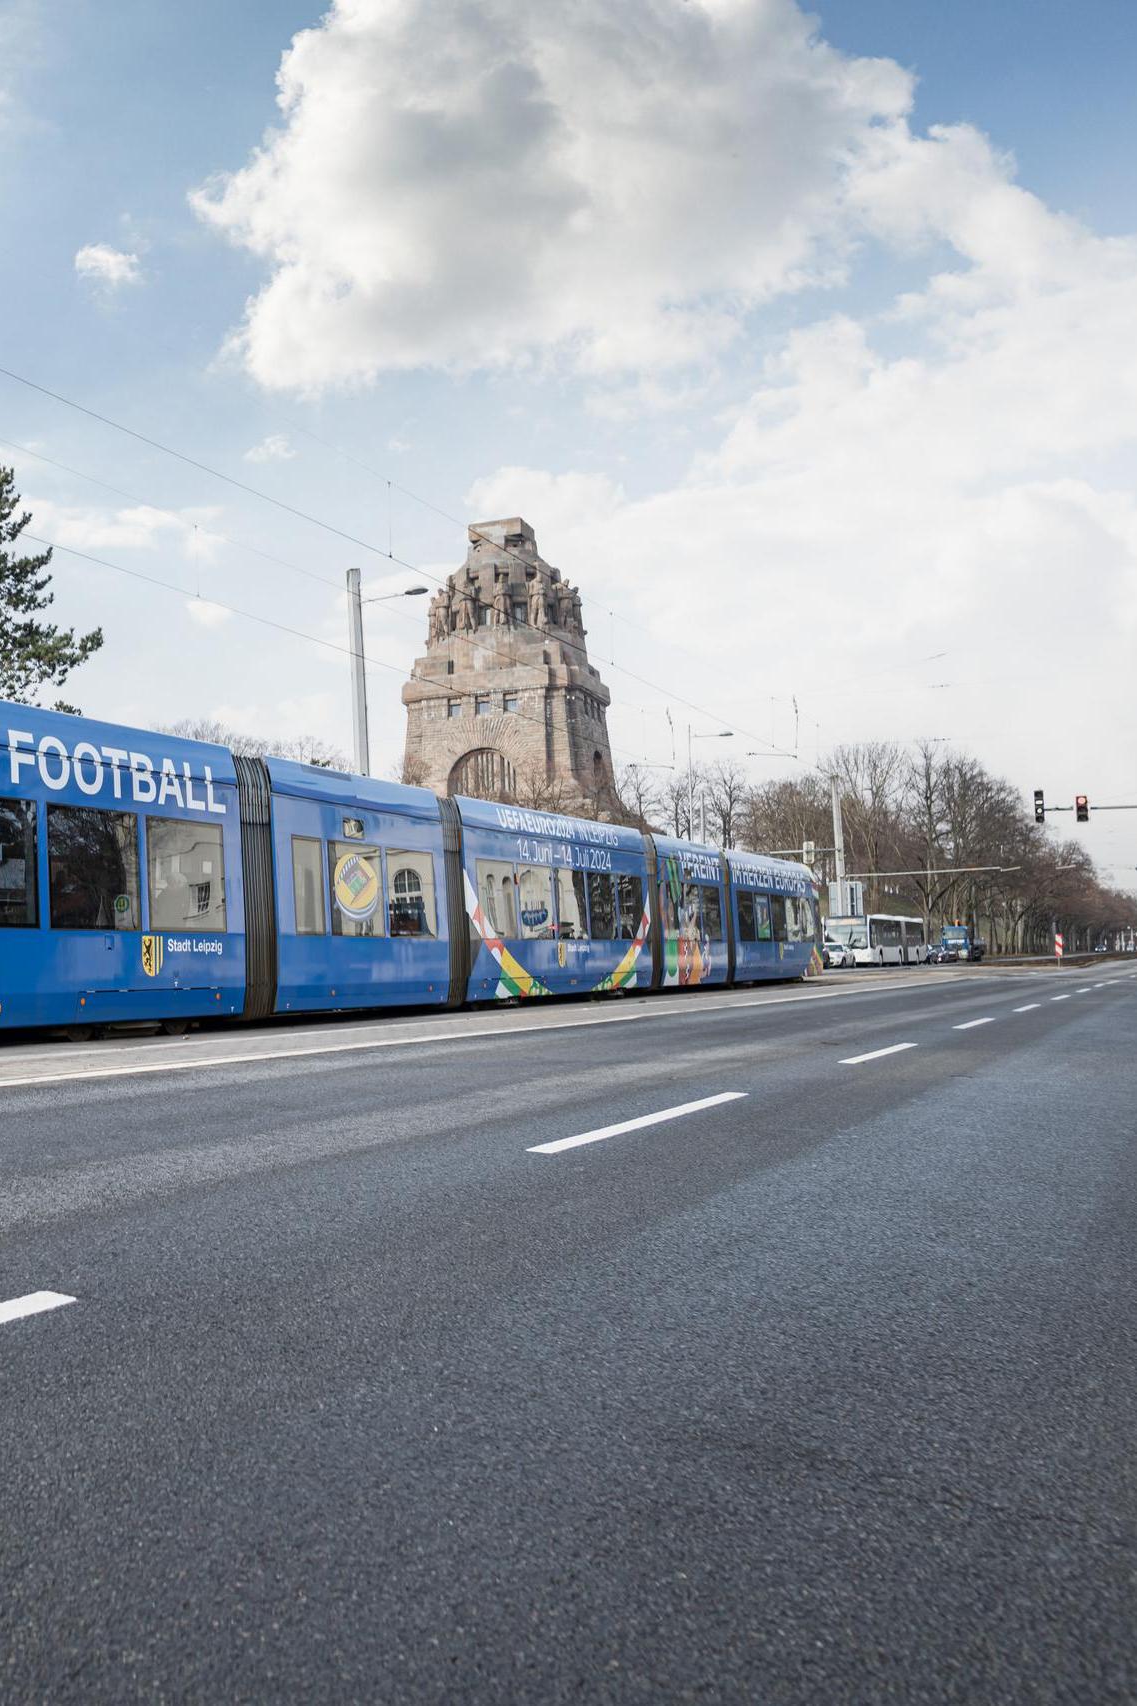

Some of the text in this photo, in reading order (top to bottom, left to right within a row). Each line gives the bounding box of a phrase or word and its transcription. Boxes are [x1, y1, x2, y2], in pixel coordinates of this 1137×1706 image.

[7, 729, 226, 814] FOOTBALL
[496, 808, 527, 831] UEFA
[524, 813, 555, 836] EURO
[556, 818, 575, 839] 2024
[587, 823, 619, 846] LEIPZIG
[517, 838, 532, 861] 14.
[533, 840, 553, 864] Juni
[561, 844, 575, 867] 14.
[575, 846, 589, 868] Juli
[590, 848, 612, 871] 2024
[678, 850, 720, 881] VEREINT
[167, 938, 223, 955] Stadt Leipzig
